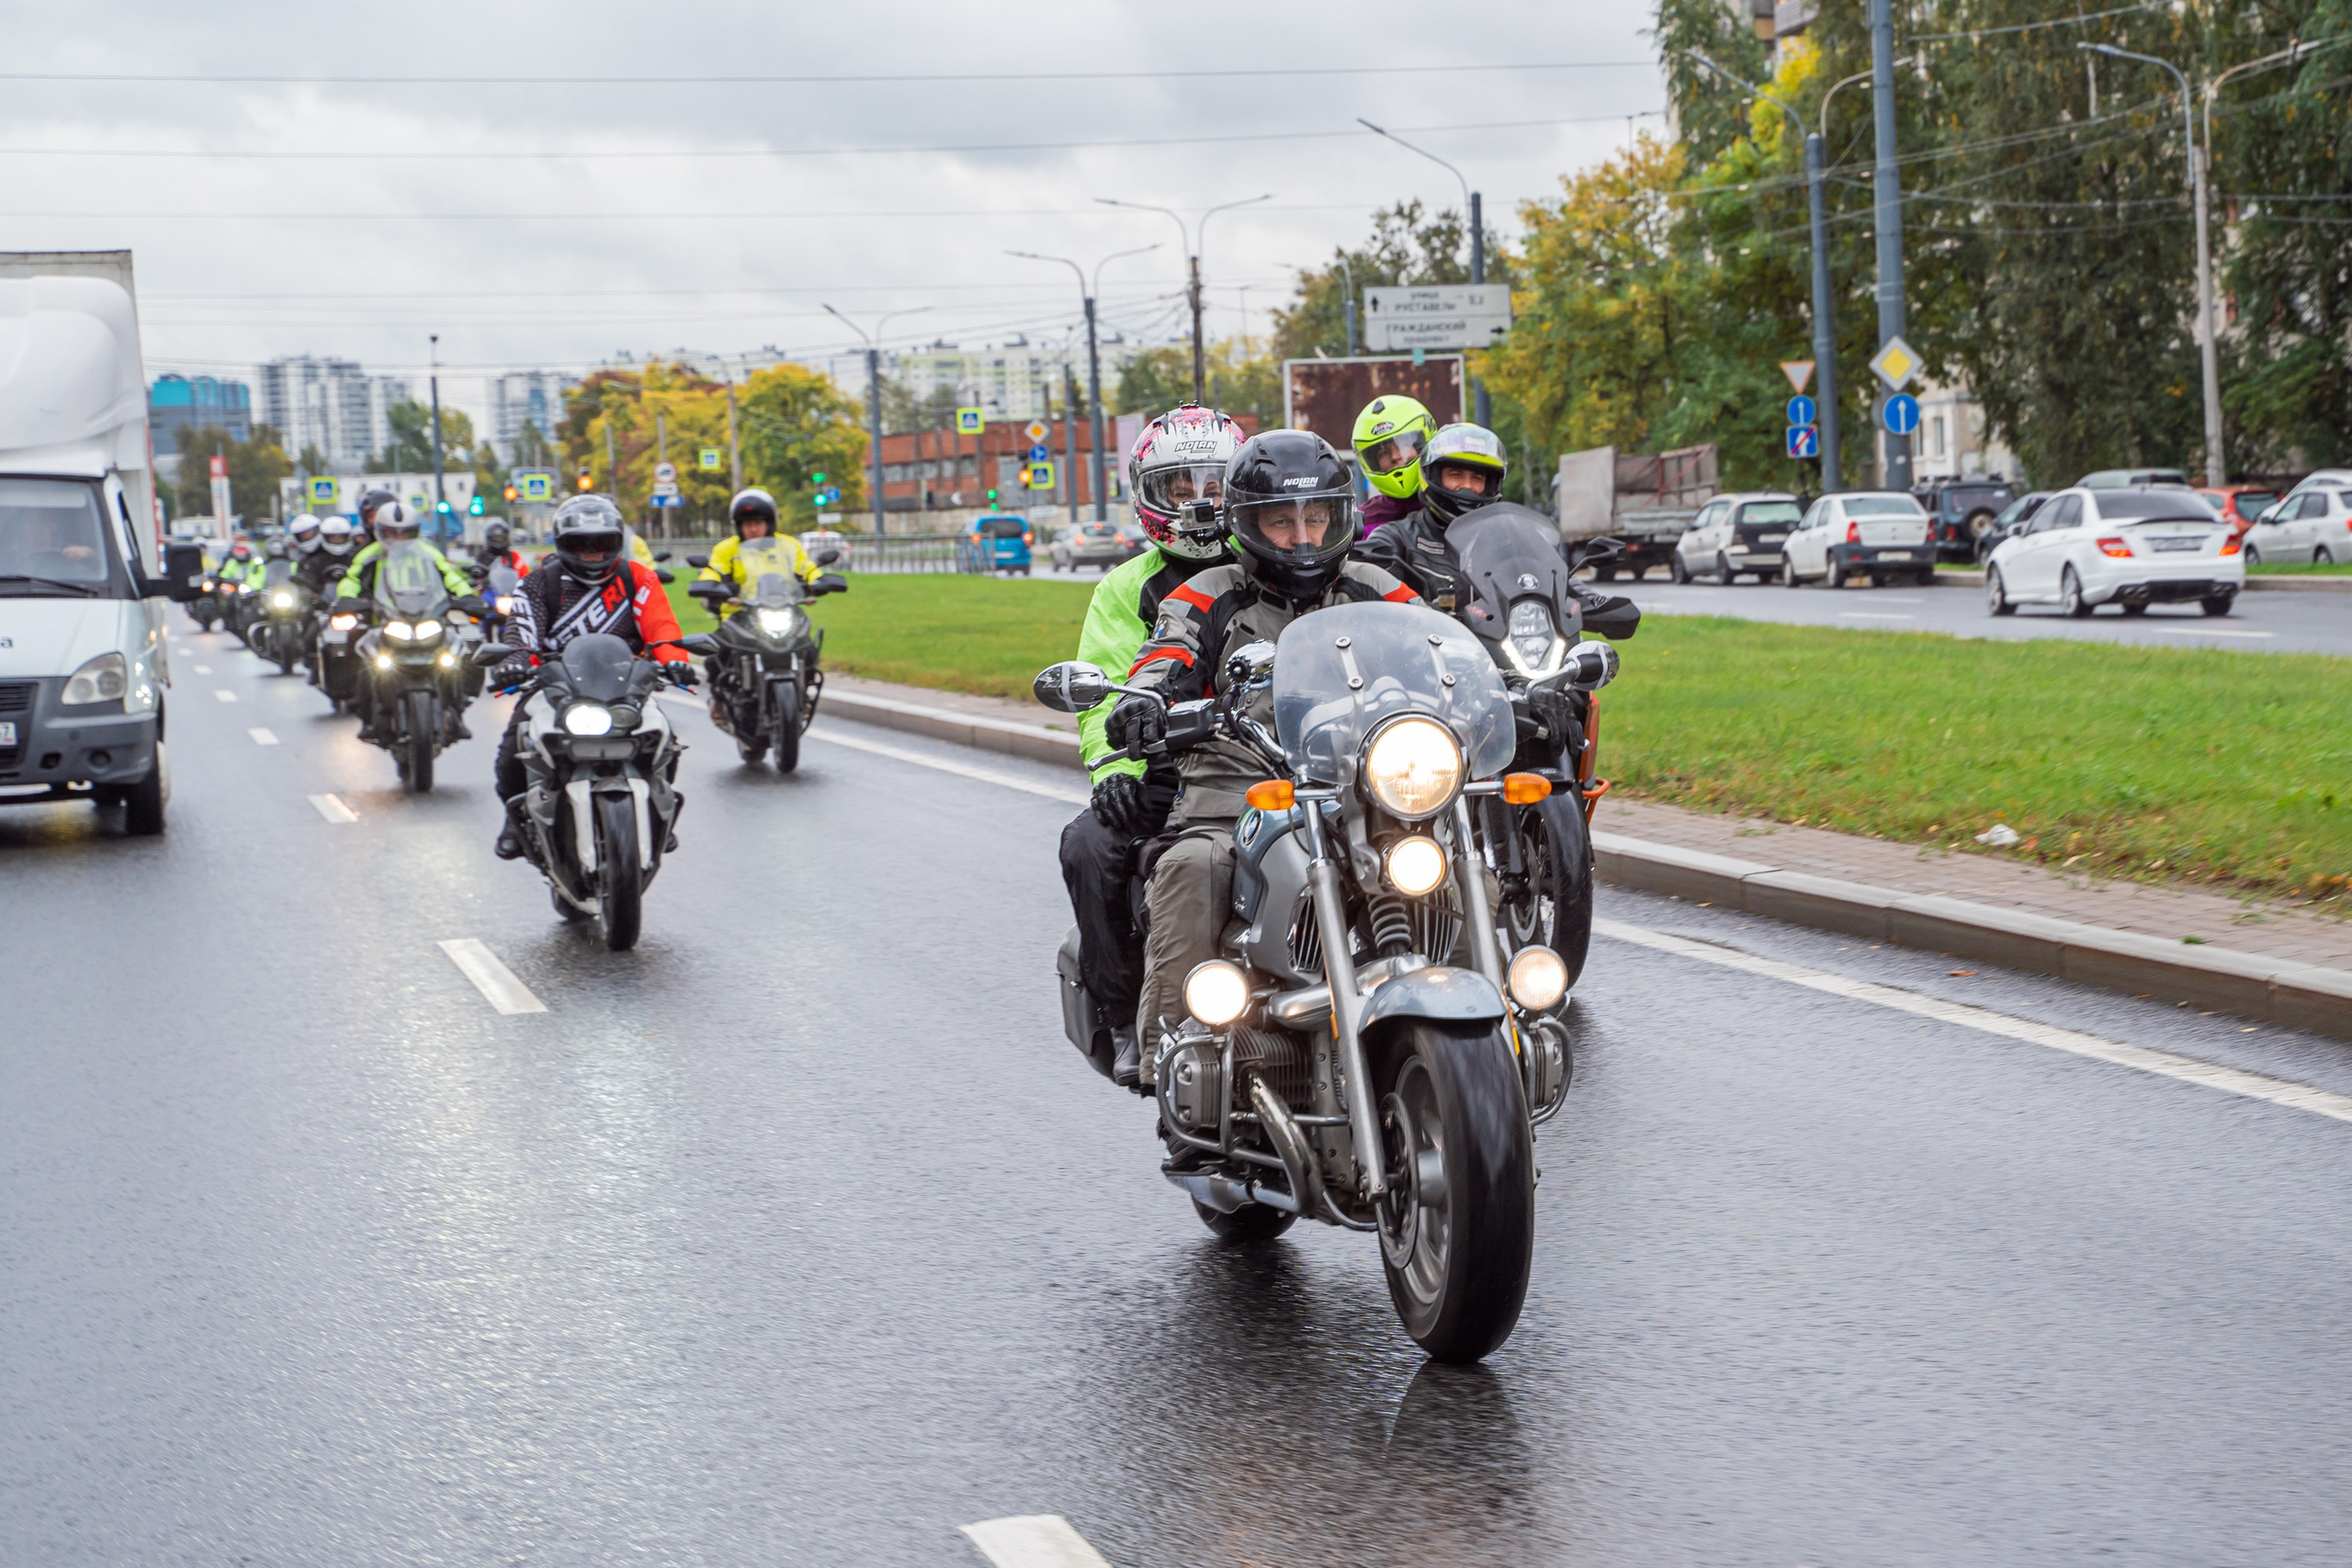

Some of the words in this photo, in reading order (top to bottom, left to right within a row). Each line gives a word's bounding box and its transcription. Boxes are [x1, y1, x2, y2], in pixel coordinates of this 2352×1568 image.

[1395, 301, 1456, 312] РУСТАВЕЛИ
[1385, 321, 1466, 333] ГРАЖДАНСКИЙ
[1175, 441, 1217, 453] NOLAN
[1283, 476, 1319, 488] NOLAN
